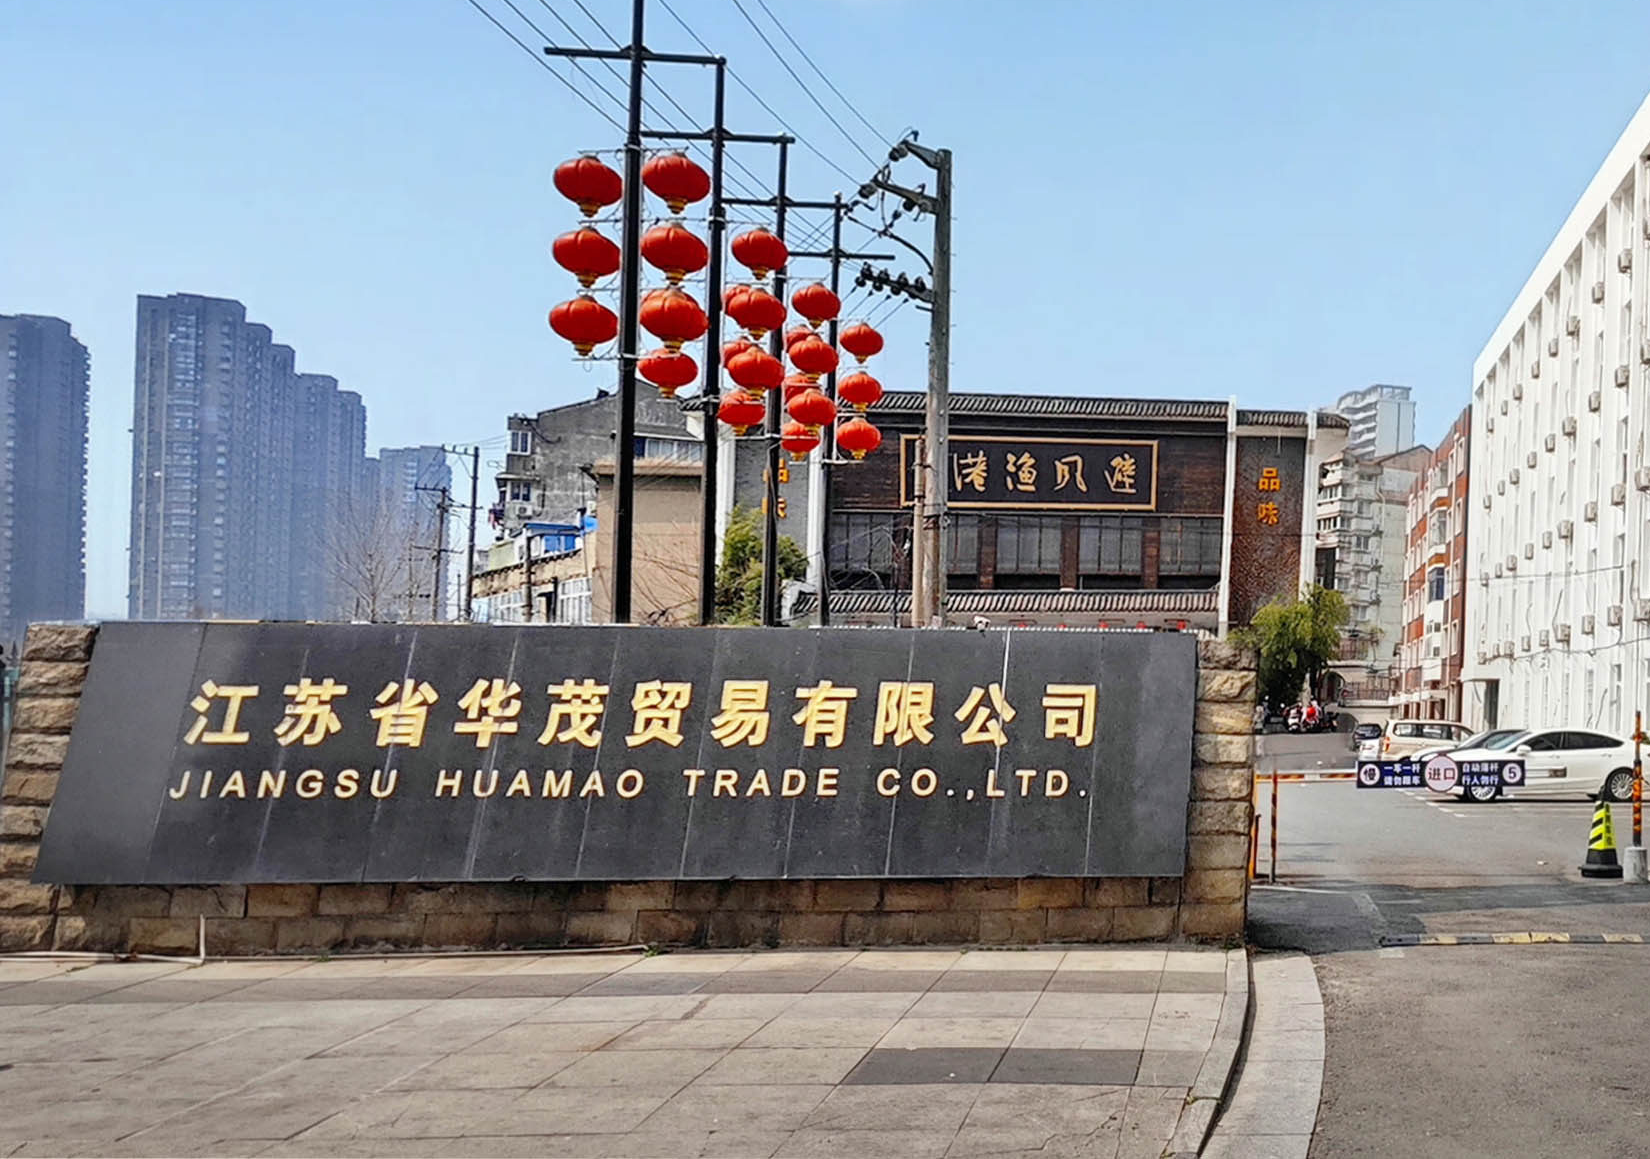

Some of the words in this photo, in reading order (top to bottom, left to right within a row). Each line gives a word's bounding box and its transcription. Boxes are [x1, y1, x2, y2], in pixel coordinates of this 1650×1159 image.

[1258, 467, 1281, 526] 品味
[184, 678, 1100, 749] 江苏省华茂贸易有限公司
[168, 768, 398, 799] JIANGSU
[434, 767, 646, 798] HUAMAO
[683, 767, 841, 797] TRADE
[876, 766, 1089, 801] CO.,LTD.
[1428, 767, 1456, 781] 进口
[1462, 774, 1499, 786] 行人勿行
[1508, 767, 1517, 780] 5
